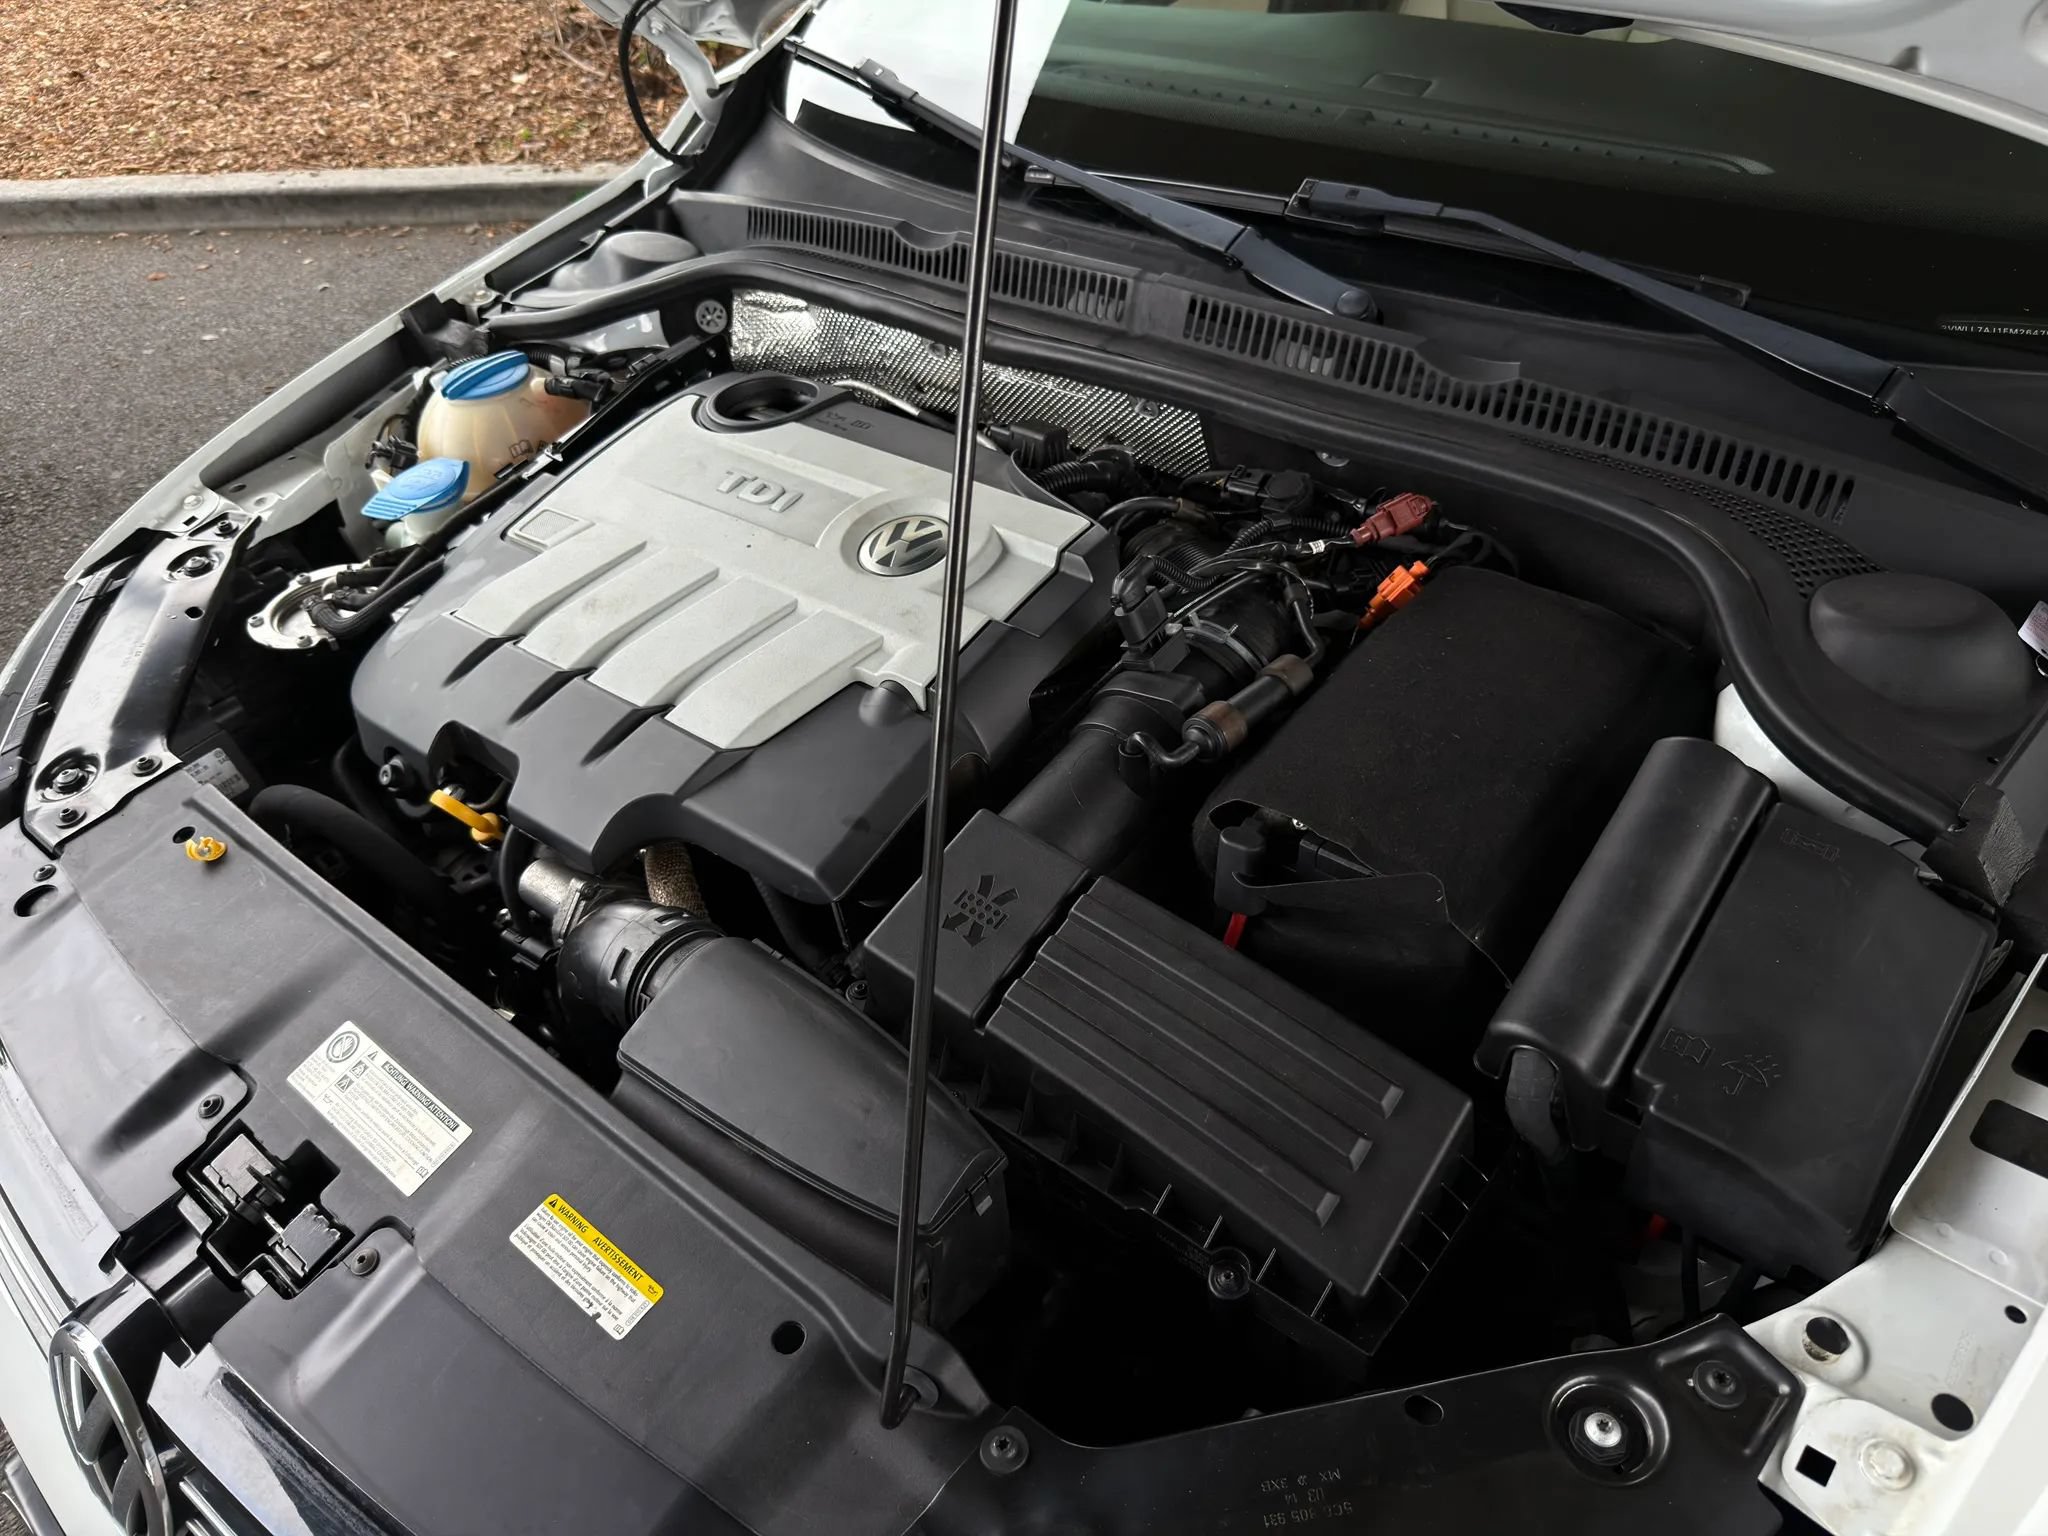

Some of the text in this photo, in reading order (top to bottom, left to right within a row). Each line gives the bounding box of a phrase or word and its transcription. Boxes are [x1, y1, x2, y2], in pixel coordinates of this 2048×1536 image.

[716, 471, 804, 513] TDI
[383, 1062, 458, 1131] ACHTUNG! WARNING! ATTENTION!
[558, 1204, 644, 1282] WARNING AVERTISSEMENT
